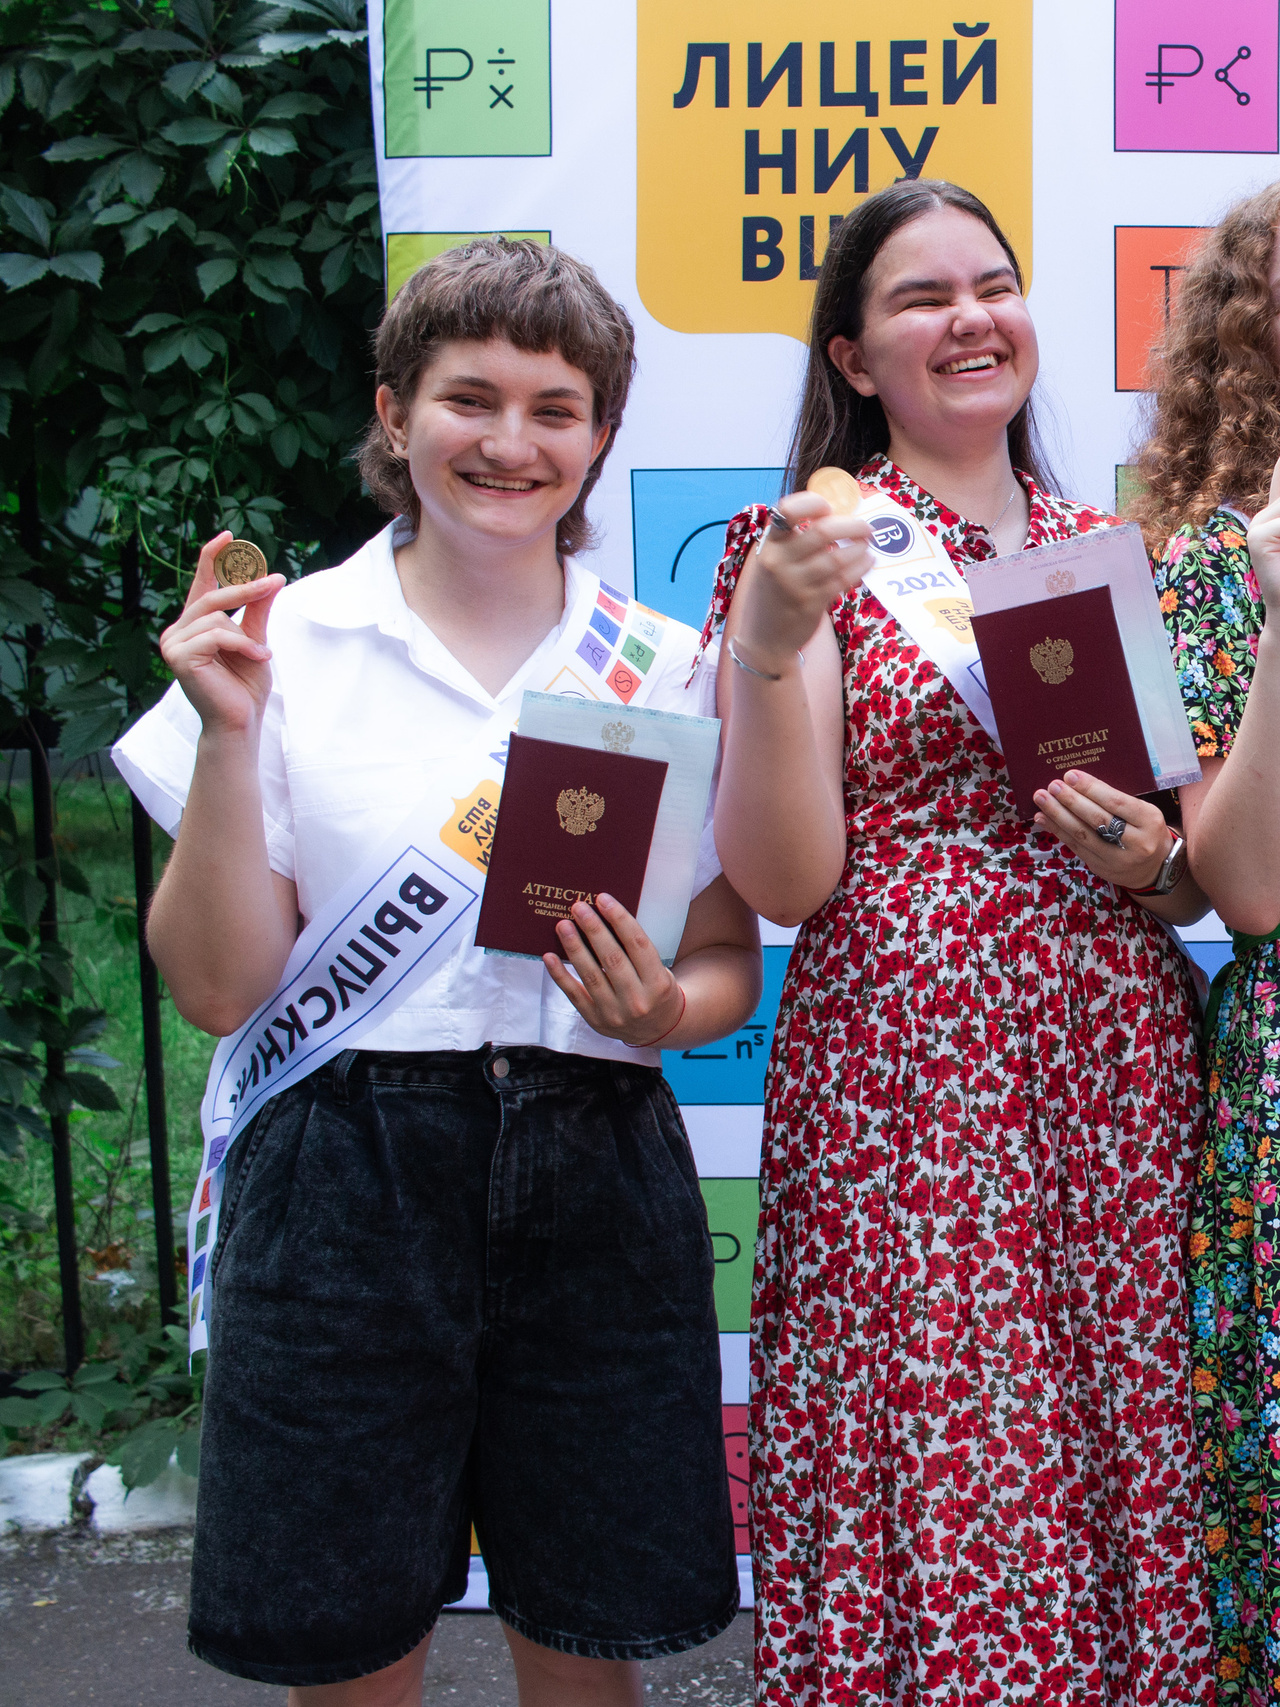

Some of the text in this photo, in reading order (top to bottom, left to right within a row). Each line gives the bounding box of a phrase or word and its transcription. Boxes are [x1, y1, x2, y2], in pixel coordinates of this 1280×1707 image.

[672, 22, 999, 118] ЛИЦЕЙ
[743, 127, 940, 195] НИУ
[887, 571, 956, 596] 2021
[938, 608, 968, 632] ВШЭ
[1037, 729, 1109, 756] АТТЕСТАТ
[1052, 752, 1082, 763] СРЕДНЕМ
[1082, 746, 1106, 756] ОБЩЕМ
[1055, 756, 1100, 770] ОБРАЗОВАНИИ
[457, 797, 492, 835] ВШЭ
[535, 900, 567, 911] СРЕДНЕМ
